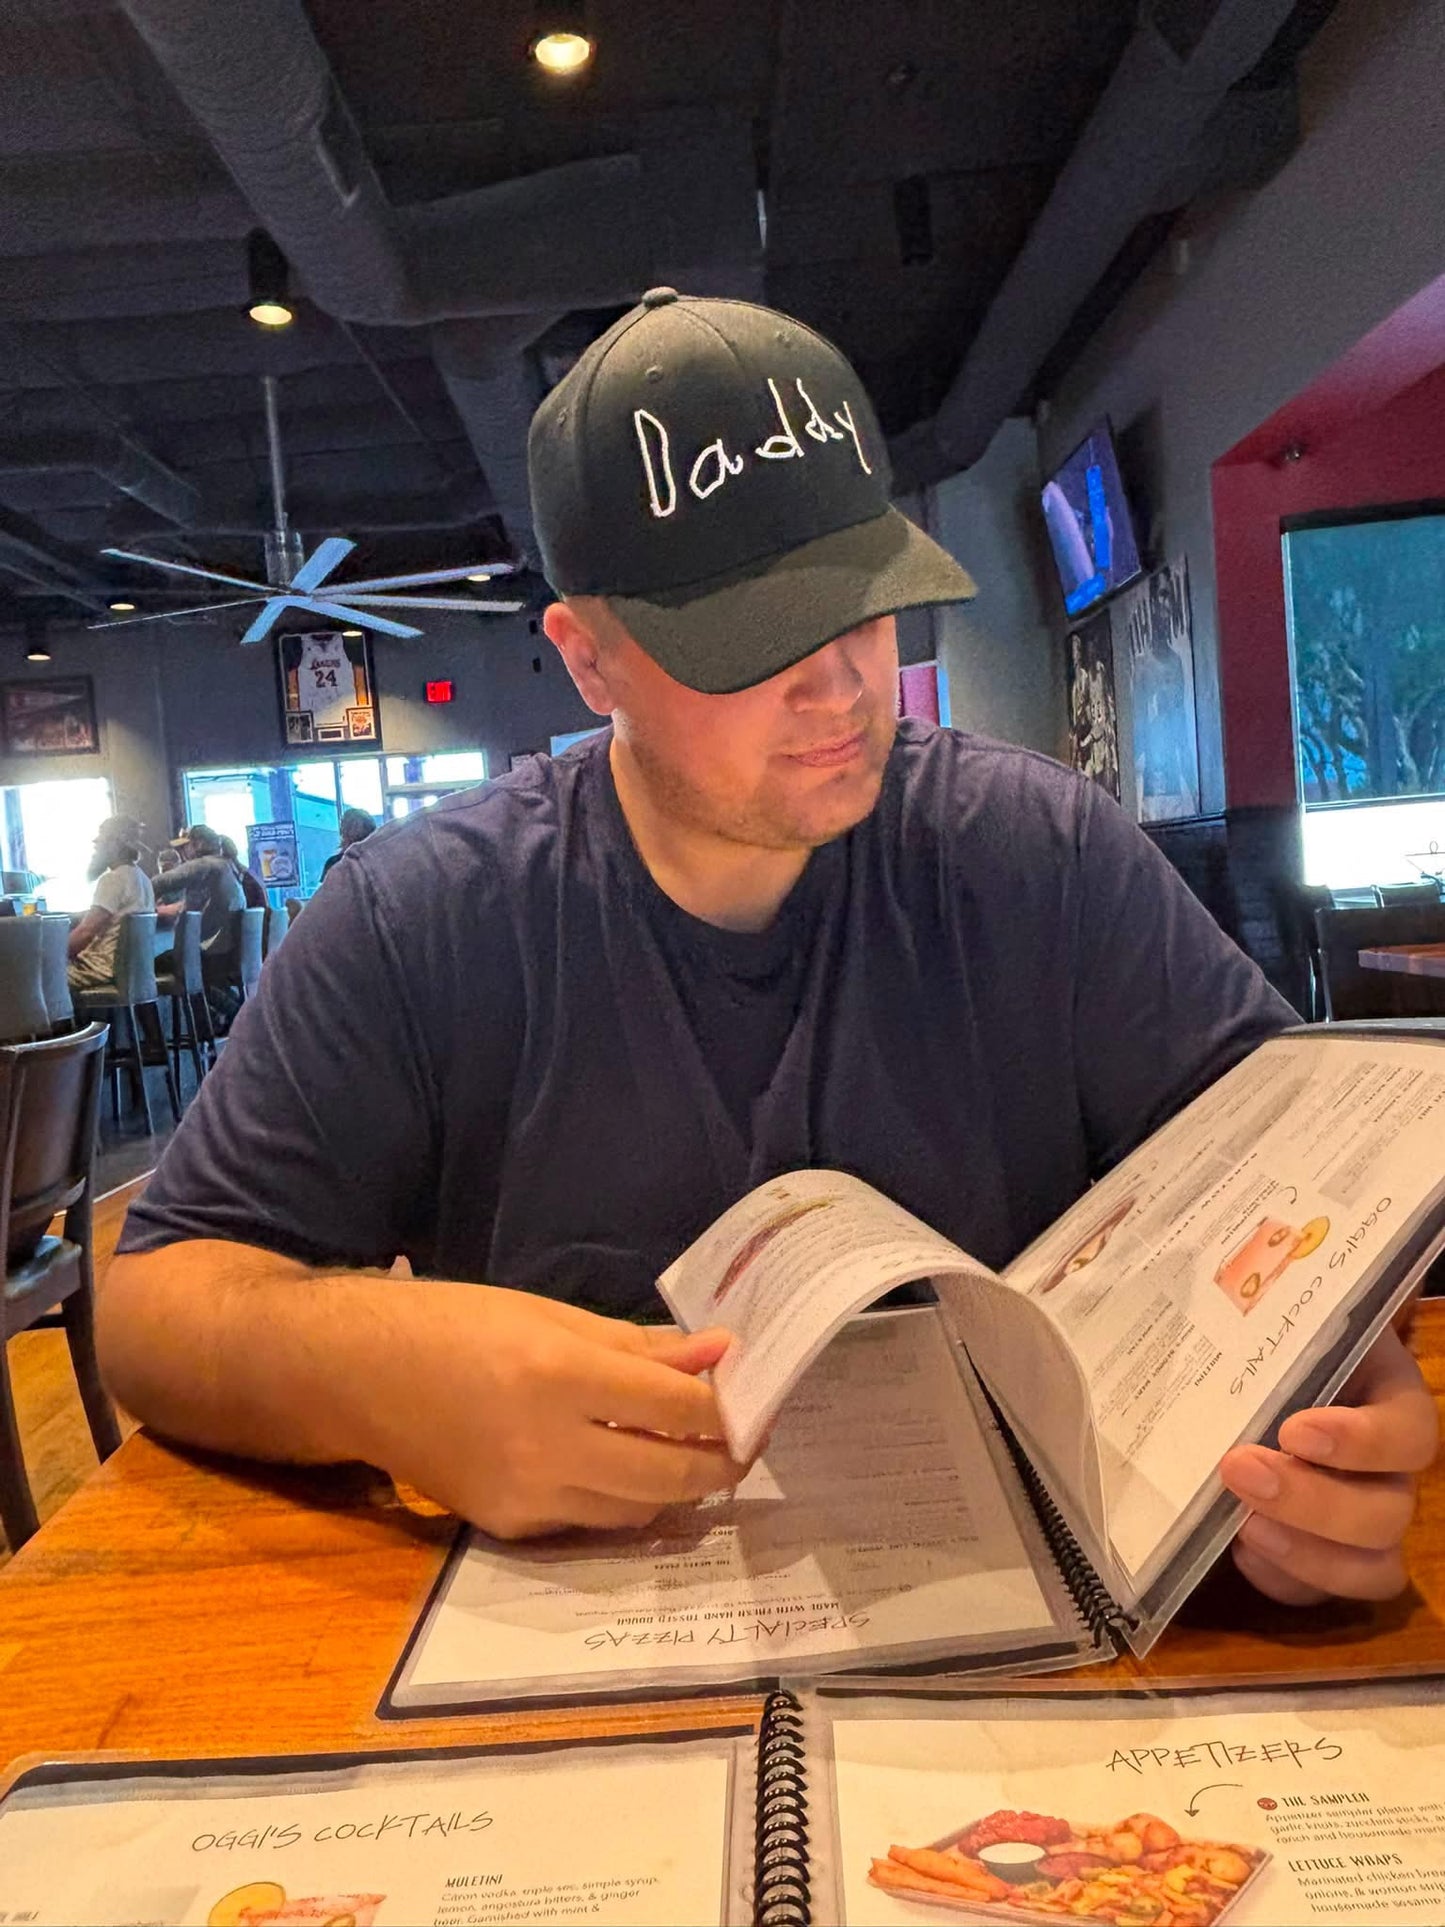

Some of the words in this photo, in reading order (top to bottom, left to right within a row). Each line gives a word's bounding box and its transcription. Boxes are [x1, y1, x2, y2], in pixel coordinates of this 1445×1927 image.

[634, 377, 872, 518] Daddy
[314, 669, 338, 688] 24
[1229, 1274, 1323, 1397] COCKTAILS
[704, 1610, 733, 1620] HAND
[707, 1611, 869, 1643] SPECIALTY
[584, 1630, 694, 1649] PIZZAS
[1106, 1737, 1342, 1774] APPETIZERS
[1310, 1792, 1370, 1805] SAMPLER
[192, 1824, 302, 1851] OGGI'S
[314, 1811, 493, 1842] COCKTAILS
[1314, 1832, 1337, 1841] and
[1288, 1857, 1347, 1872] LETTUCE
[1349, 1853, 1403, 1867] WRAPS
[445, 1874, 503, 1887] MULETINI
[582, 1879, 621, 1889] simple
[1366, 1870, 1415, 1882] chicken
[482, 1899, 541, 1911] angostura
[588, 1892, 597, 1901] &
[600, 1890, 640, 1901] ginger
[1354, 1887, 1366, 1897] &
[1368, 1885, 1417, 1896] wonton
[467, 1911, 530, 1923] Garnished
[533, 1908, 557, 1917] with
[561, 1905, 588, 1914] mint
[591, 1903, 600, 1912] &
[1311, 1899, 1389, 1912] housemade
